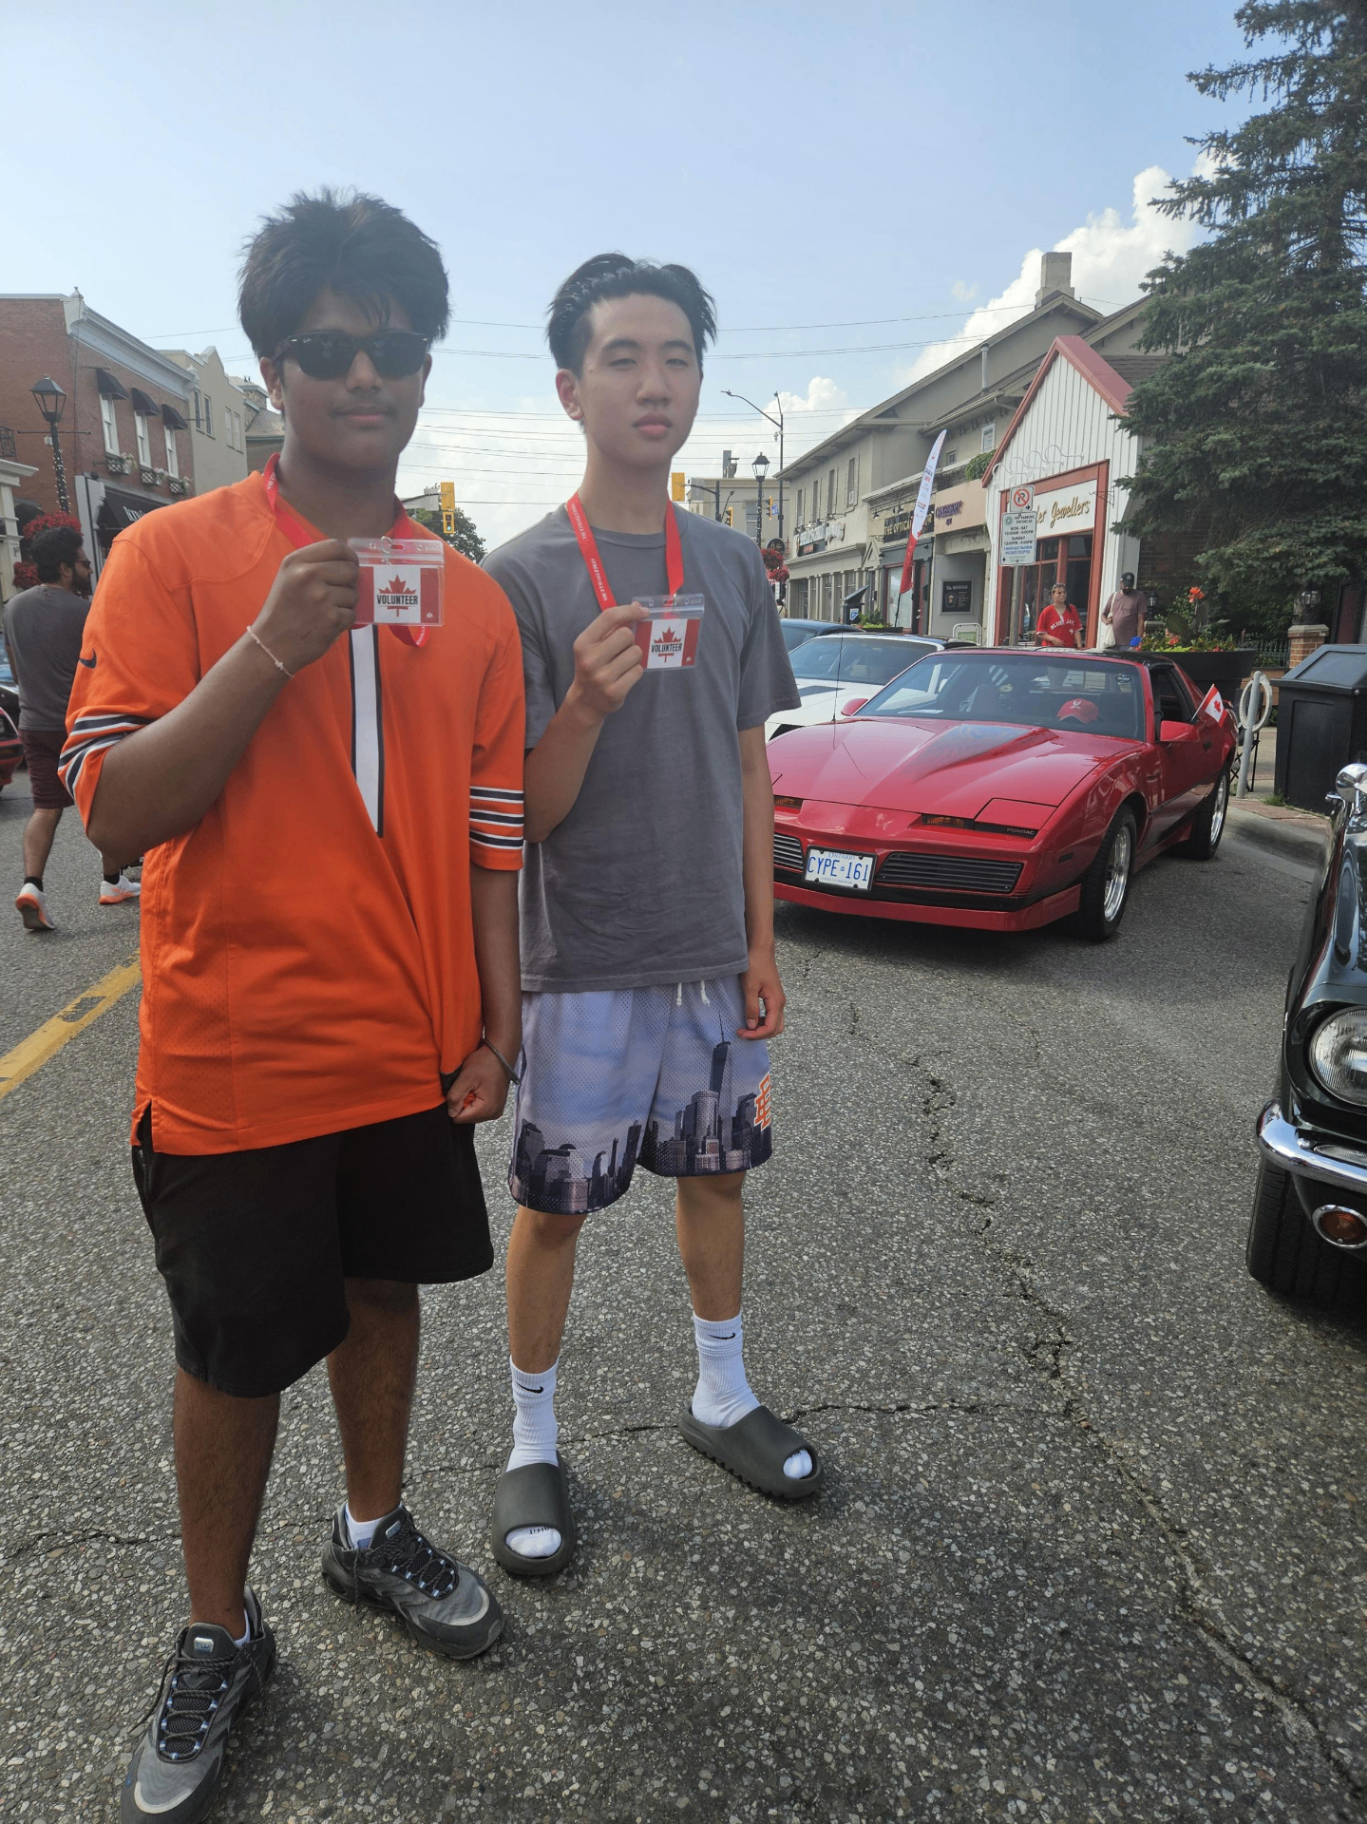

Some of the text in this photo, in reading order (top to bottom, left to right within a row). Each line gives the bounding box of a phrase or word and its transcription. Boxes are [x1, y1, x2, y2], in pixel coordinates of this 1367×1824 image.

[1050, 496, 1091, 529] Jewellers
[376, 594, 419, 606] VOLUNTEER
[651, 643, 683, 653] VOLUNTEER
[1006, 827, 1035, 836] PONTIAC
[828, 852, 856, 860] ONTARIO
